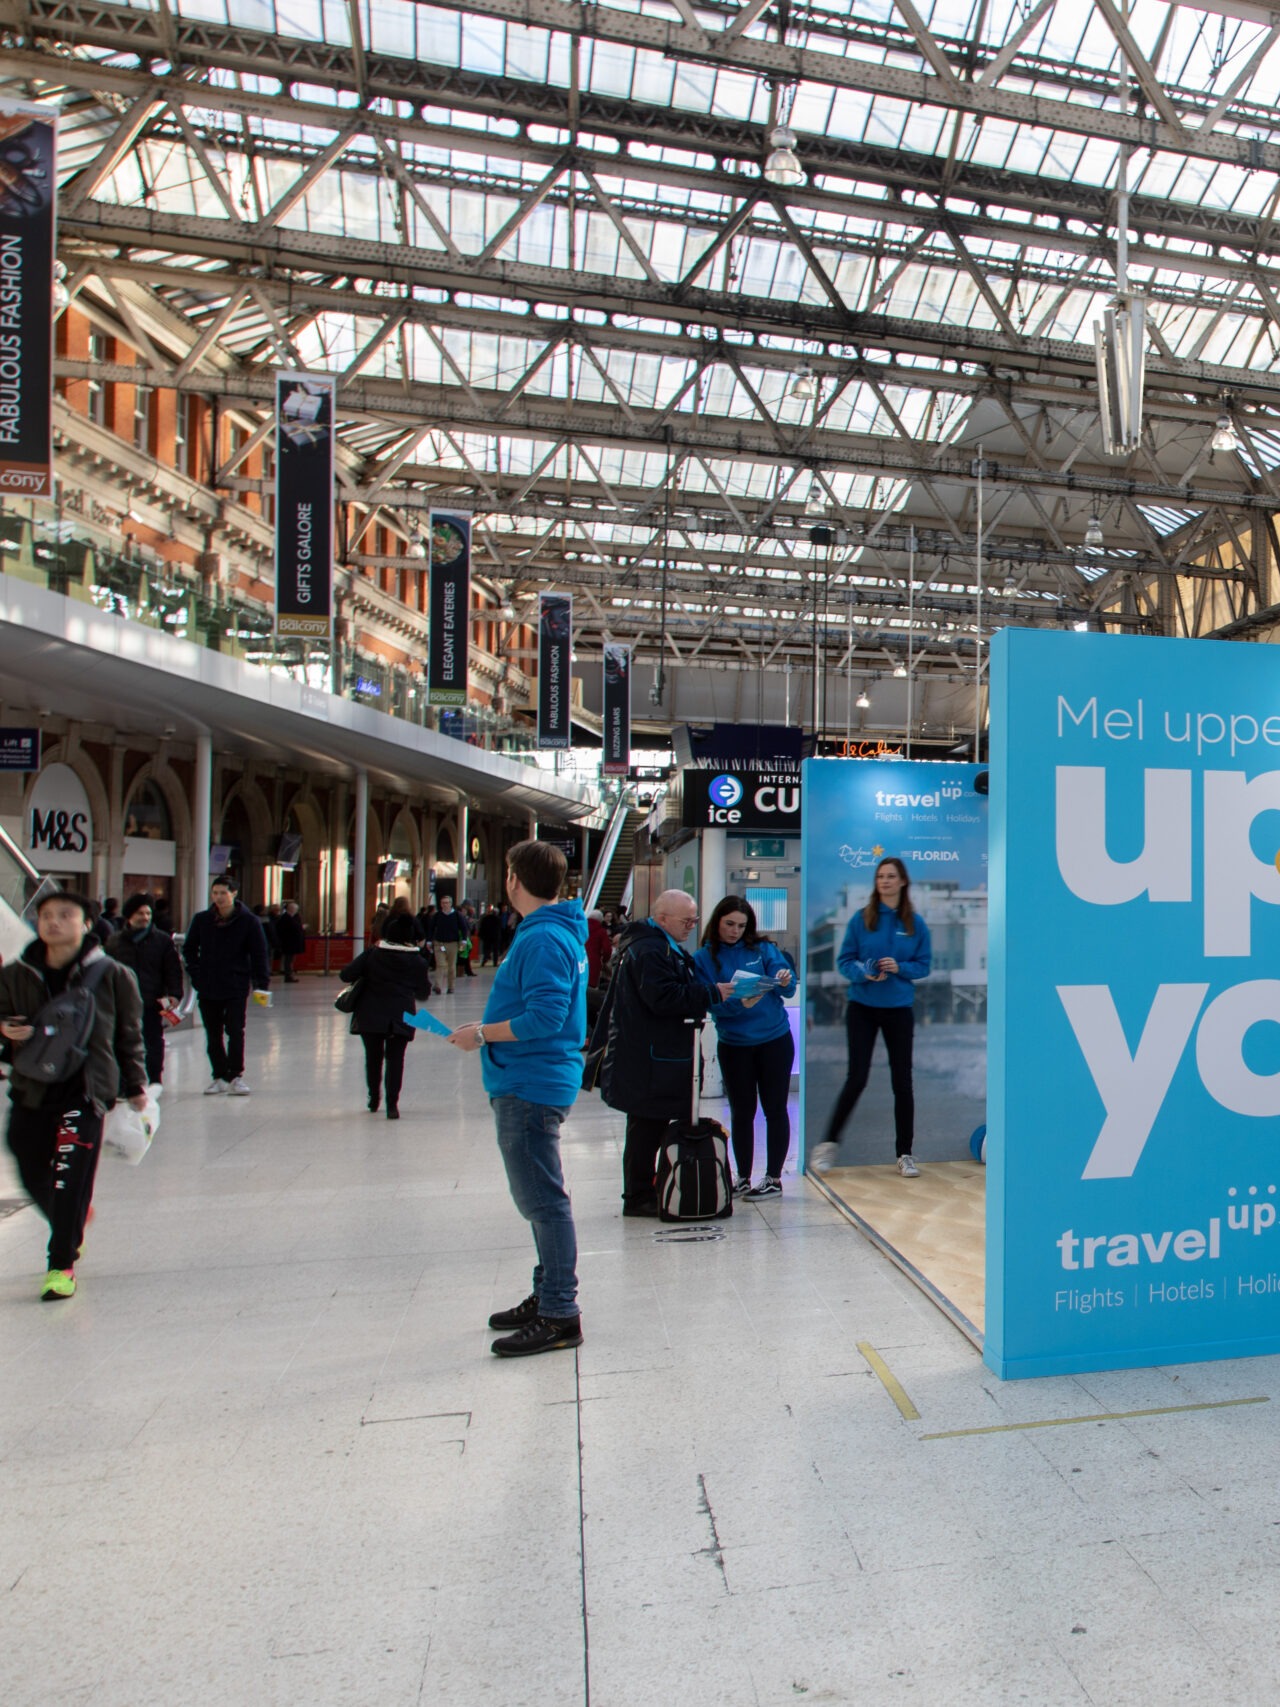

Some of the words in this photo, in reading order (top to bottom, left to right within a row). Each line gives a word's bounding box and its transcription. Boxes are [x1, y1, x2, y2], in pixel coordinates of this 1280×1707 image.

[0, 235, 23, 329] FASHION
[0, 334, 22, 444] FABULOUS
[296, 502, 312, 560] GALORE
[296, 563, 312, 604] GIFTS
[279, 618, 328, 635] Balcony
[444, 582, 456, 632] EATERIES
[443, 633, 455, 681] ELEGANT
[550, 645, 560, 685] FASHION
[550, 686, 559, 729] FABULOUS
[612, 706, 621, 727] BARS
[1057, 695, 1144, 740] Mel
[612, 727, 621, 759] BUZZING
[759, 775, 802, 784] INTERN
[875, 791, 940, 807] travel
[31, 807, 88, 853] M&S
[708, 804, 742, 824] ice
[875, 812, 903, 823] Flights
[911, 812, 938, 822] Hotels
[946, 814, 981, 824] Holidays
[912, 850, 960, 862] FLORIDA
[1056, 1217, 1221, 1270] travel
[1055, 1287, 1124, 1314] Flights
[1149, 1278, 1215, 1303] Hotels
